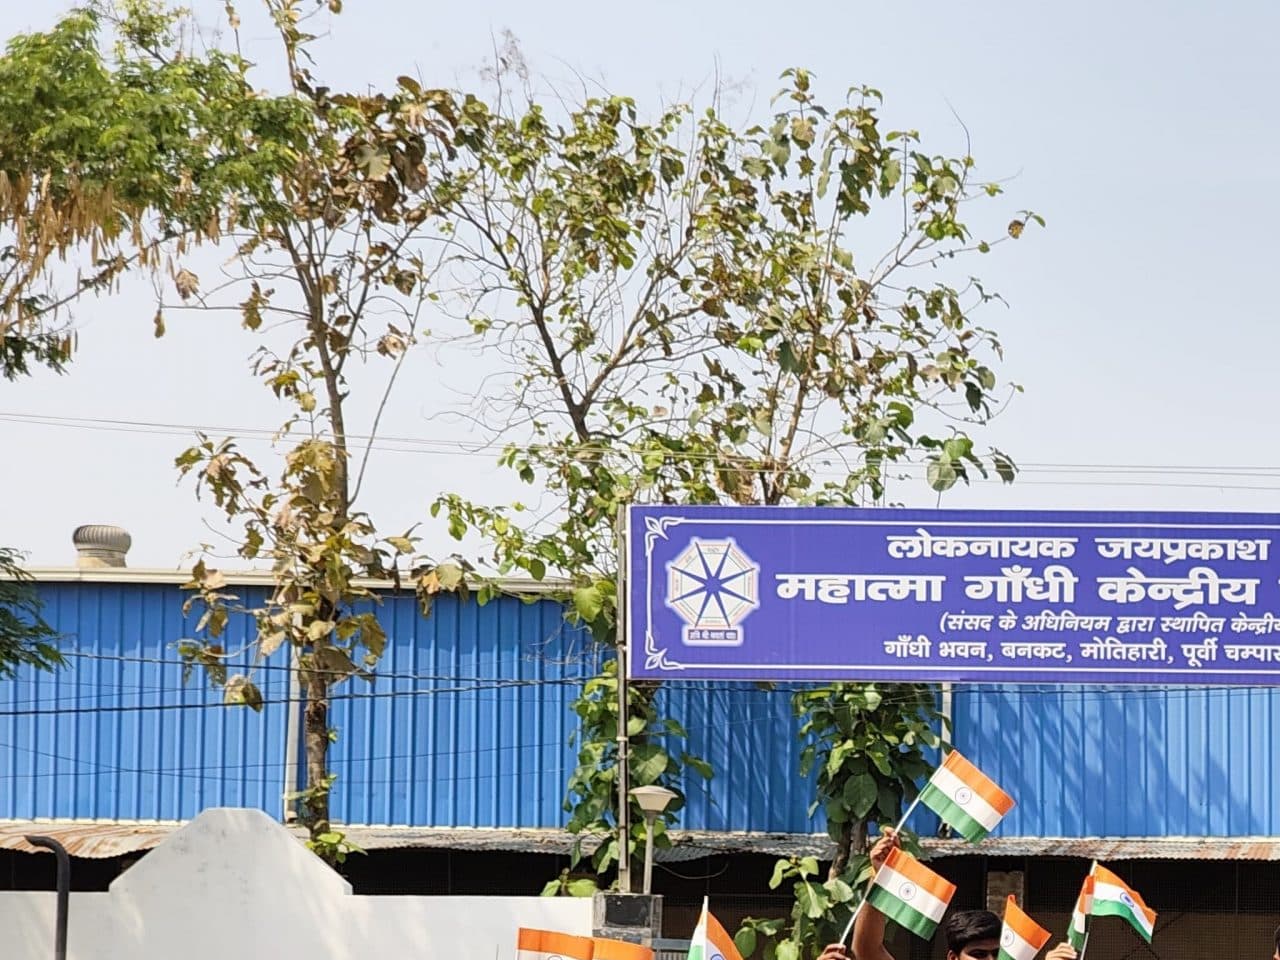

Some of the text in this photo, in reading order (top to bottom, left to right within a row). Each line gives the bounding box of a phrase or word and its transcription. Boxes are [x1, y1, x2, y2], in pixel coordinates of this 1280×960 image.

[887, 528, 1079, 559] लोकनायक
[1095, 537, 1271, 565] जयप्रकाश
[775, 573, 947, 604] महात्मा
[964, 564, 1079, 603] गाँधी
[1097, 566, 1261, 611] केन्द्रीय
[939, 610, 994, 633] (संसद
[998, 609, 1018, 631] के
[1021, 610, 1113, 633] अधिनियम
[1116, 614, 1155, 634] द्वारा
[1160, 610, 1227, 634] स्थापित
[883, 634, 932, 658] गाँधी
[938, 640, 994, 662] भवन,
[999, 641, 1073, 663] बनकट,
[1079, 636, 1174, 665] मोतिहारी,
[1180, 637, 1219, 668] पूर्वी
